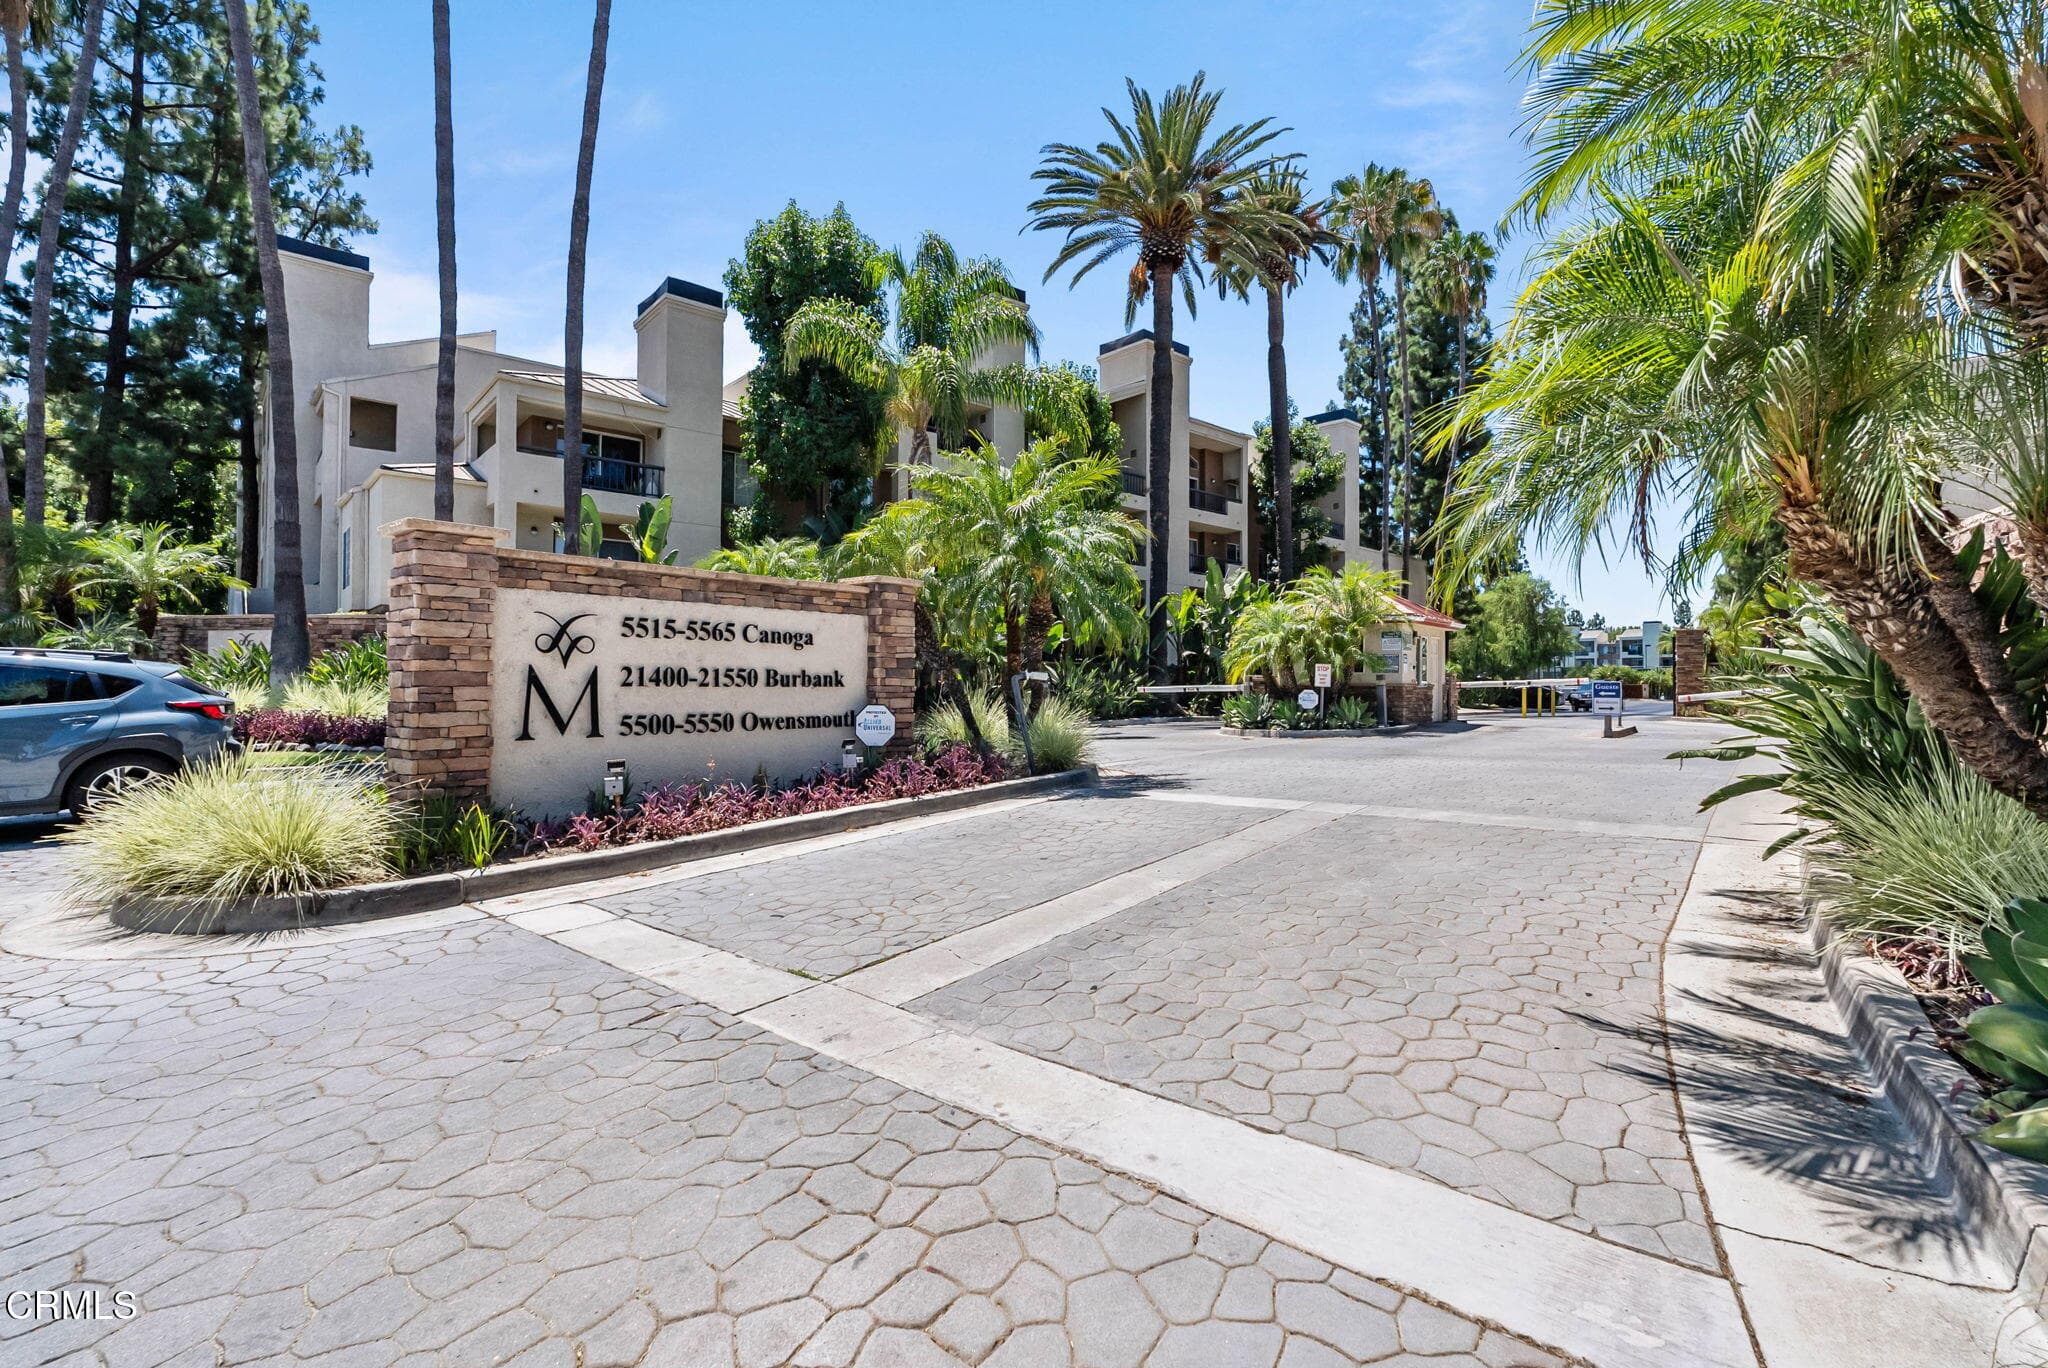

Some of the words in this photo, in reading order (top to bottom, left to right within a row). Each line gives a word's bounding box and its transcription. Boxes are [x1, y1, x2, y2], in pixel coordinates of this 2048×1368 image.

[620, 616, 736, 642] 5515-5565
[742, 624, 814, 650] Canoga
[620, 666, 758, 688] 21400-21550
[765, 669, 845, 688] Burbank
[515, 664, 604, 741] M
[619, 712, 734, 736] 5500-5550
